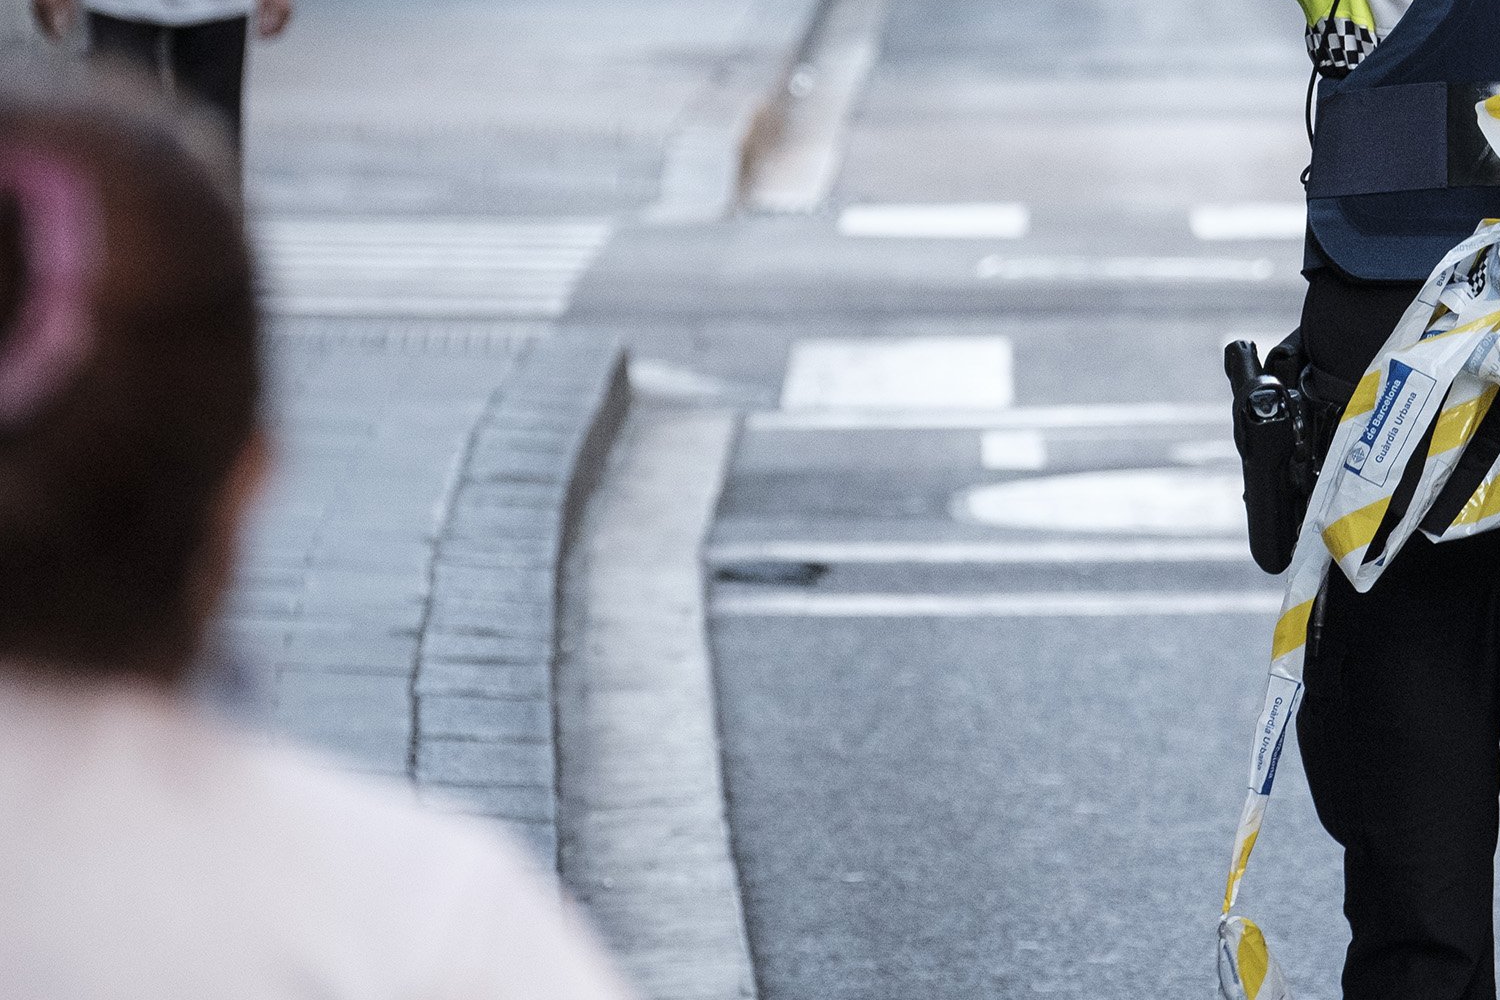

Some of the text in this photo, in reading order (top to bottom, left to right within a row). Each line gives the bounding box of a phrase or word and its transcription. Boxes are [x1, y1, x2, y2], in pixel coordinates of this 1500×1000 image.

[1366, 428, 1377, 441] de
[1372, 379, 1401, 427] Barcelona
[1375, 427, 1399, 464] Guàrdia
[1394, 392, 1417, 425] Urbana
[1257, 697, 1283, 771] Guàrdia Urbana
